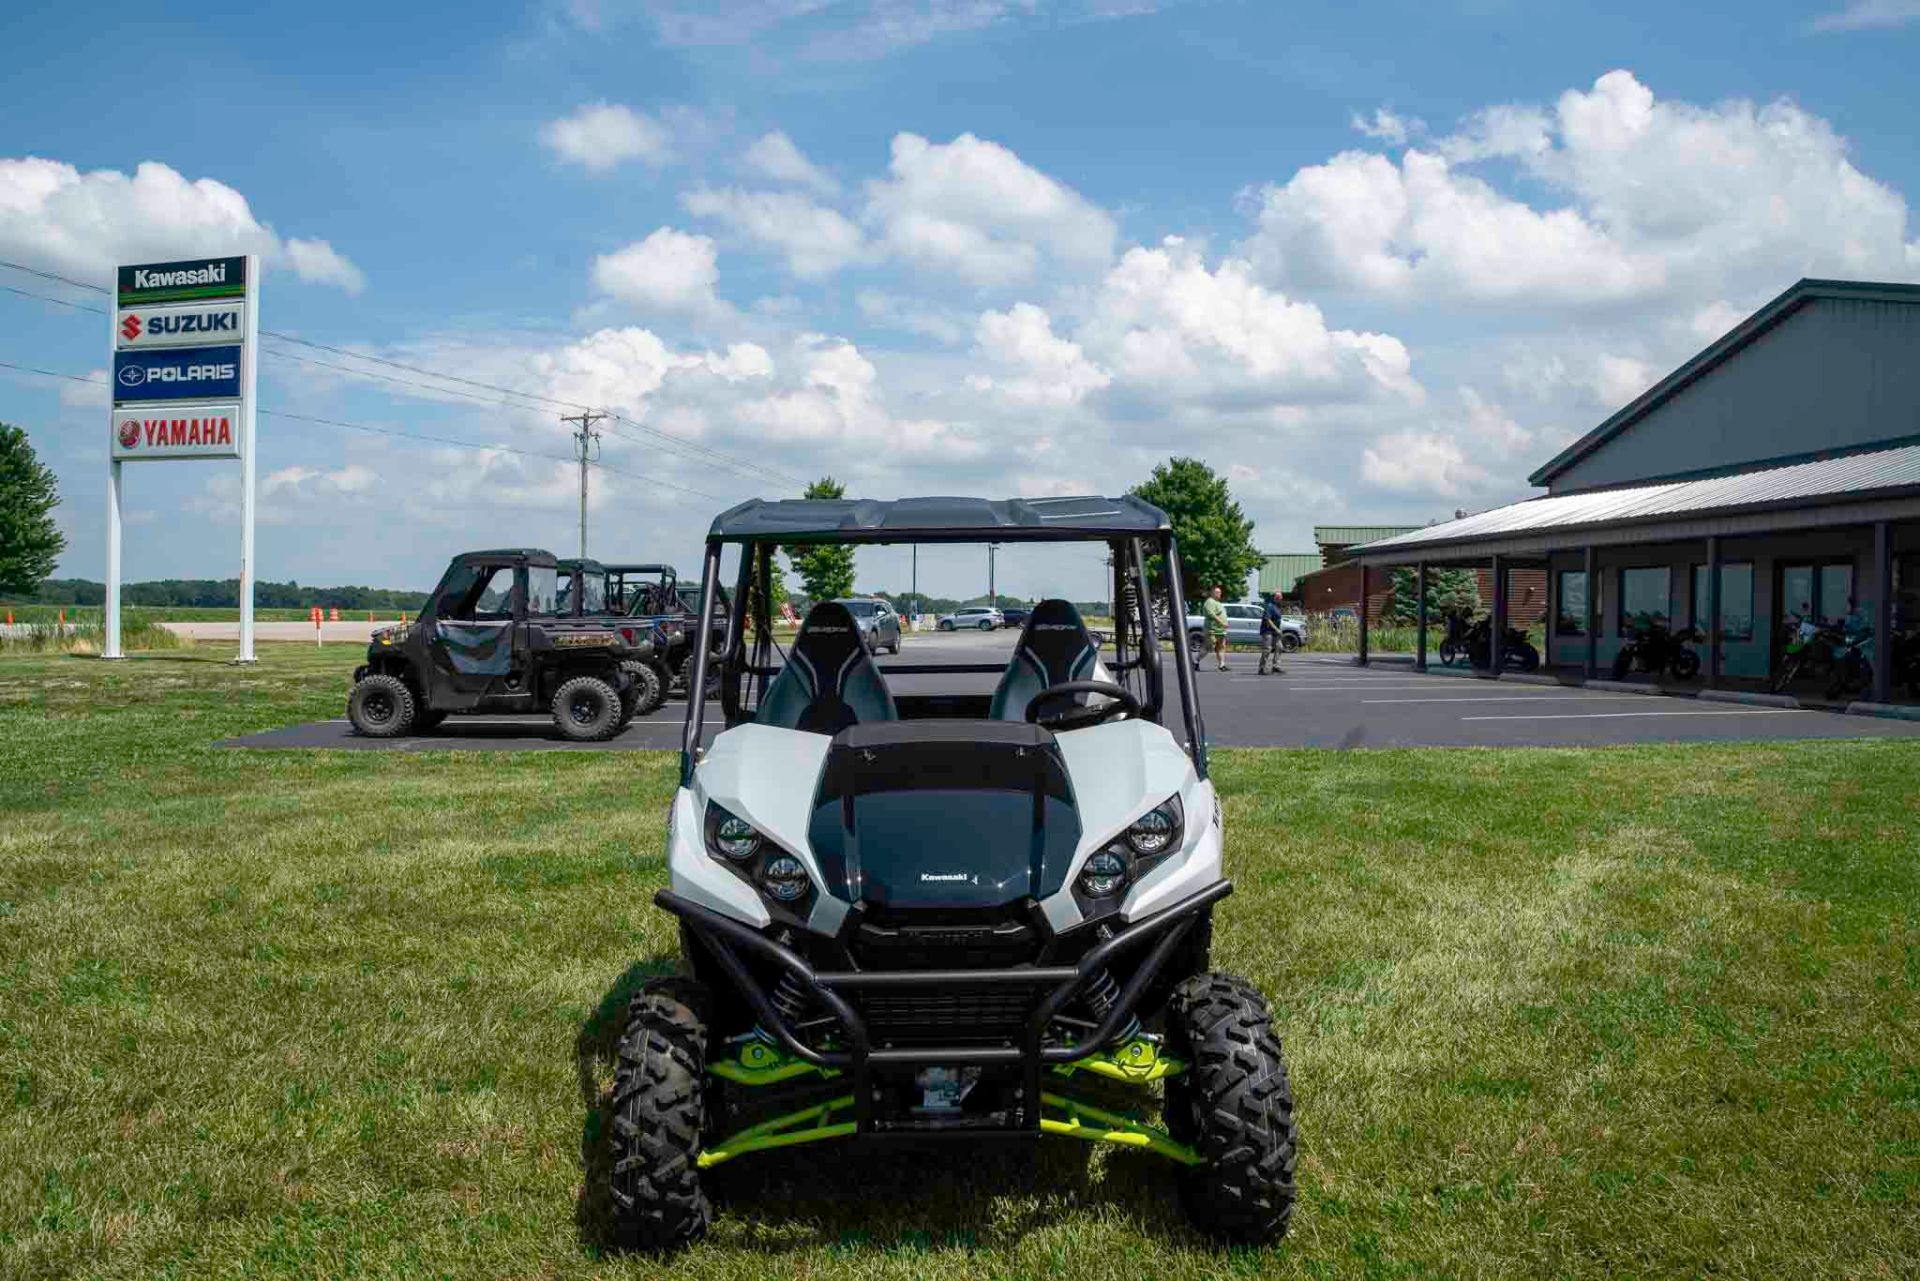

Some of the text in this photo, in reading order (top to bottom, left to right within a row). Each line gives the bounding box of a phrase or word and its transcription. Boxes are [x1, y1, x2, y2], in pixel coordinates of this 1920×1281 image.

[135, 264, 226, 288] Kawasaki
[147, 312, 237, 334] SUZUKI
[146, 364, 236, 383] POLARIS
[144, 417, 231, 446] YAMAHA
[921, 873, 968, 881] Kawasaki
